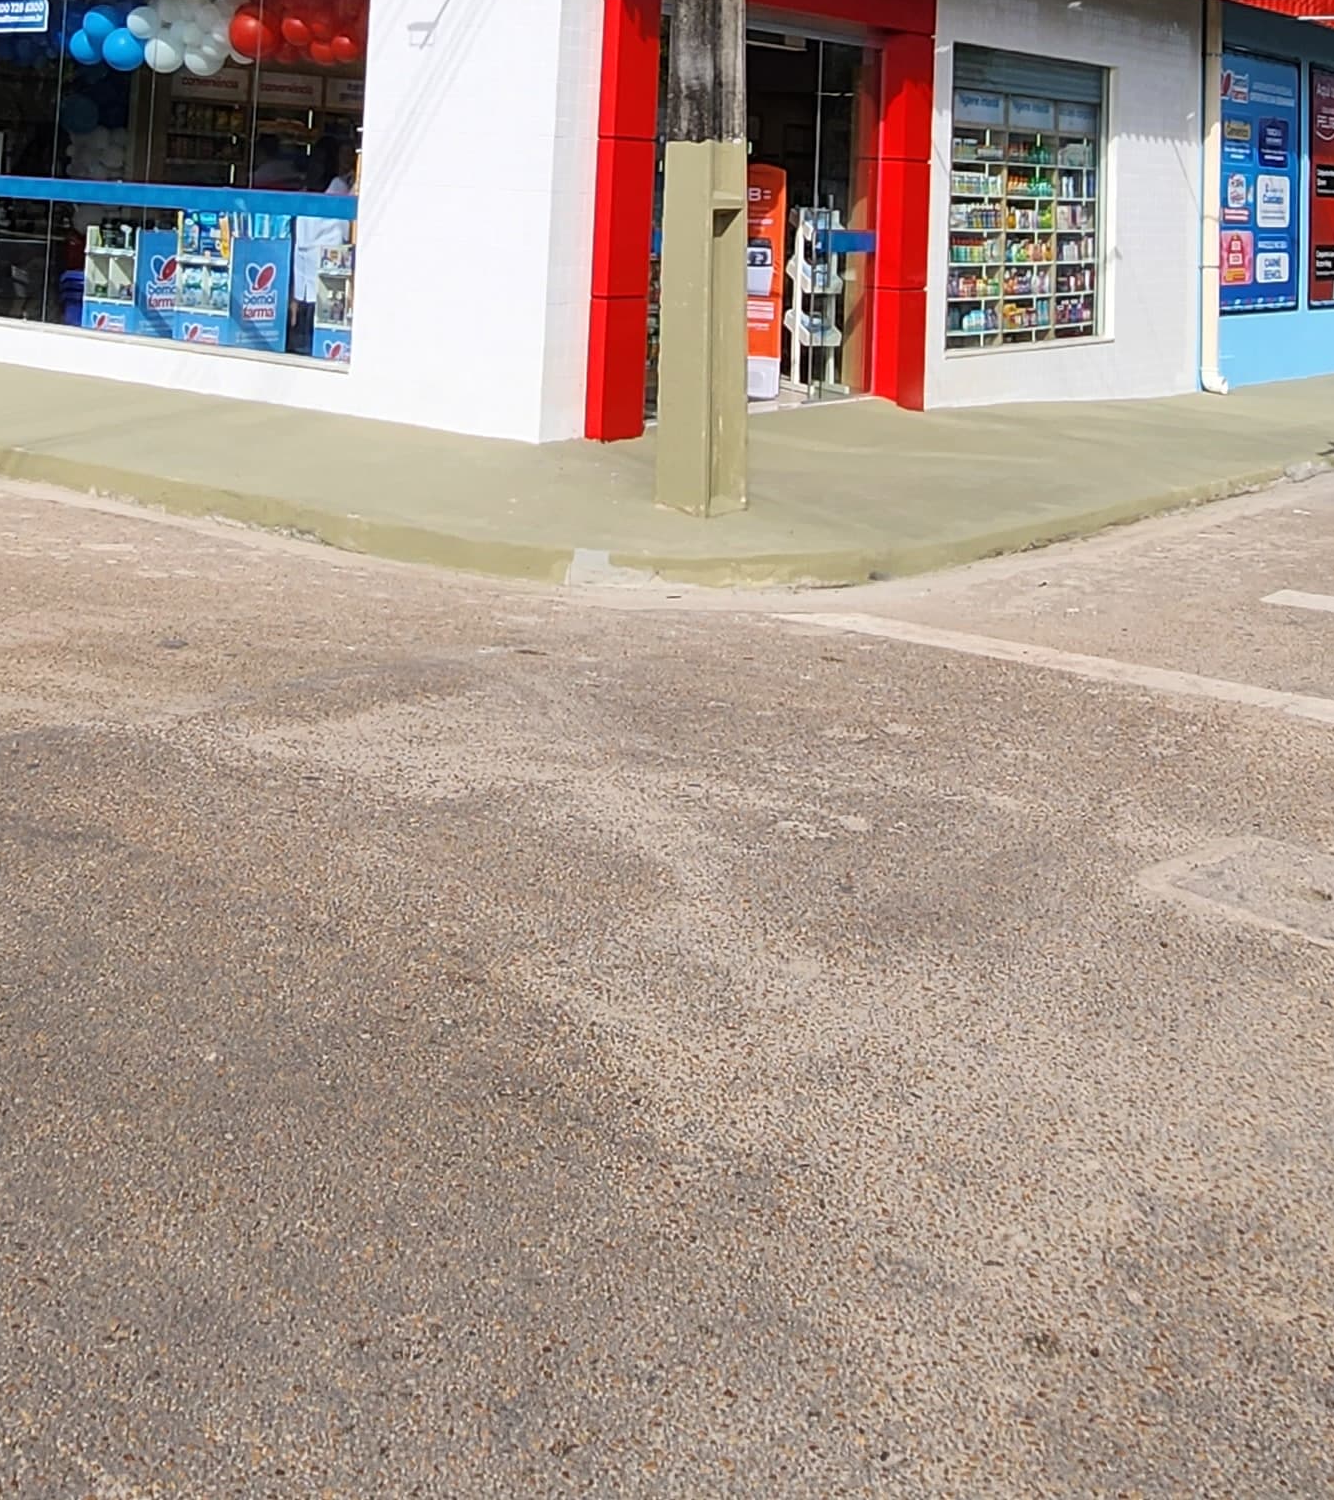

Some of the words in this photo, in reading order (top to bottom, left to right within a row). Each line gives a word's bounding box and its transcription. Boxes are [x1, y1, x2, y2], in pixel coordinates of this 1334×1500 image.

[147, 283, 177, 296] bemo
[148, 295, 175, 309] farm
[243, 304, 274, 319] farma
